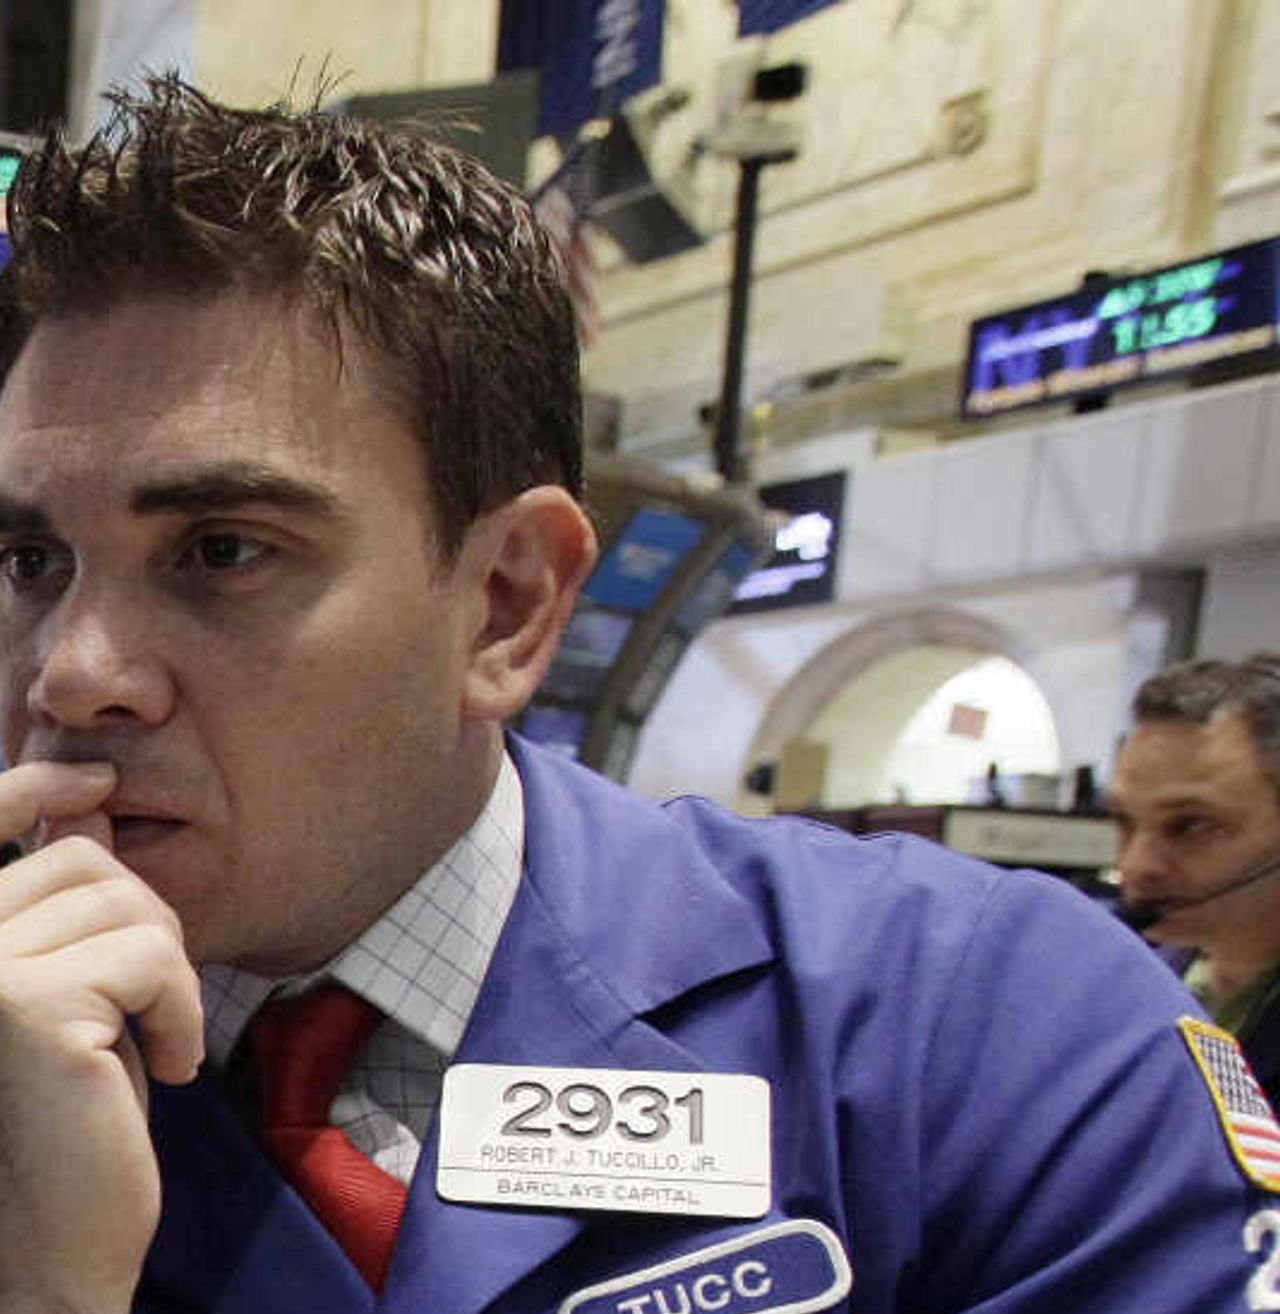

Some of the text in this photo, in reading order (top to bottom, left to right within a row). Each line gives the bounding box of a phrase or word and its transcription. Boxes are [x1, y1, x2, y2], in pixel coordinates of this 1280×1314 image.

[501, 1081, 704, 1145] 2931
[480, 1144, 556, 1169] ROBERT
[497, 1179, 701, 1206] BARCLAYS CAPITAL
